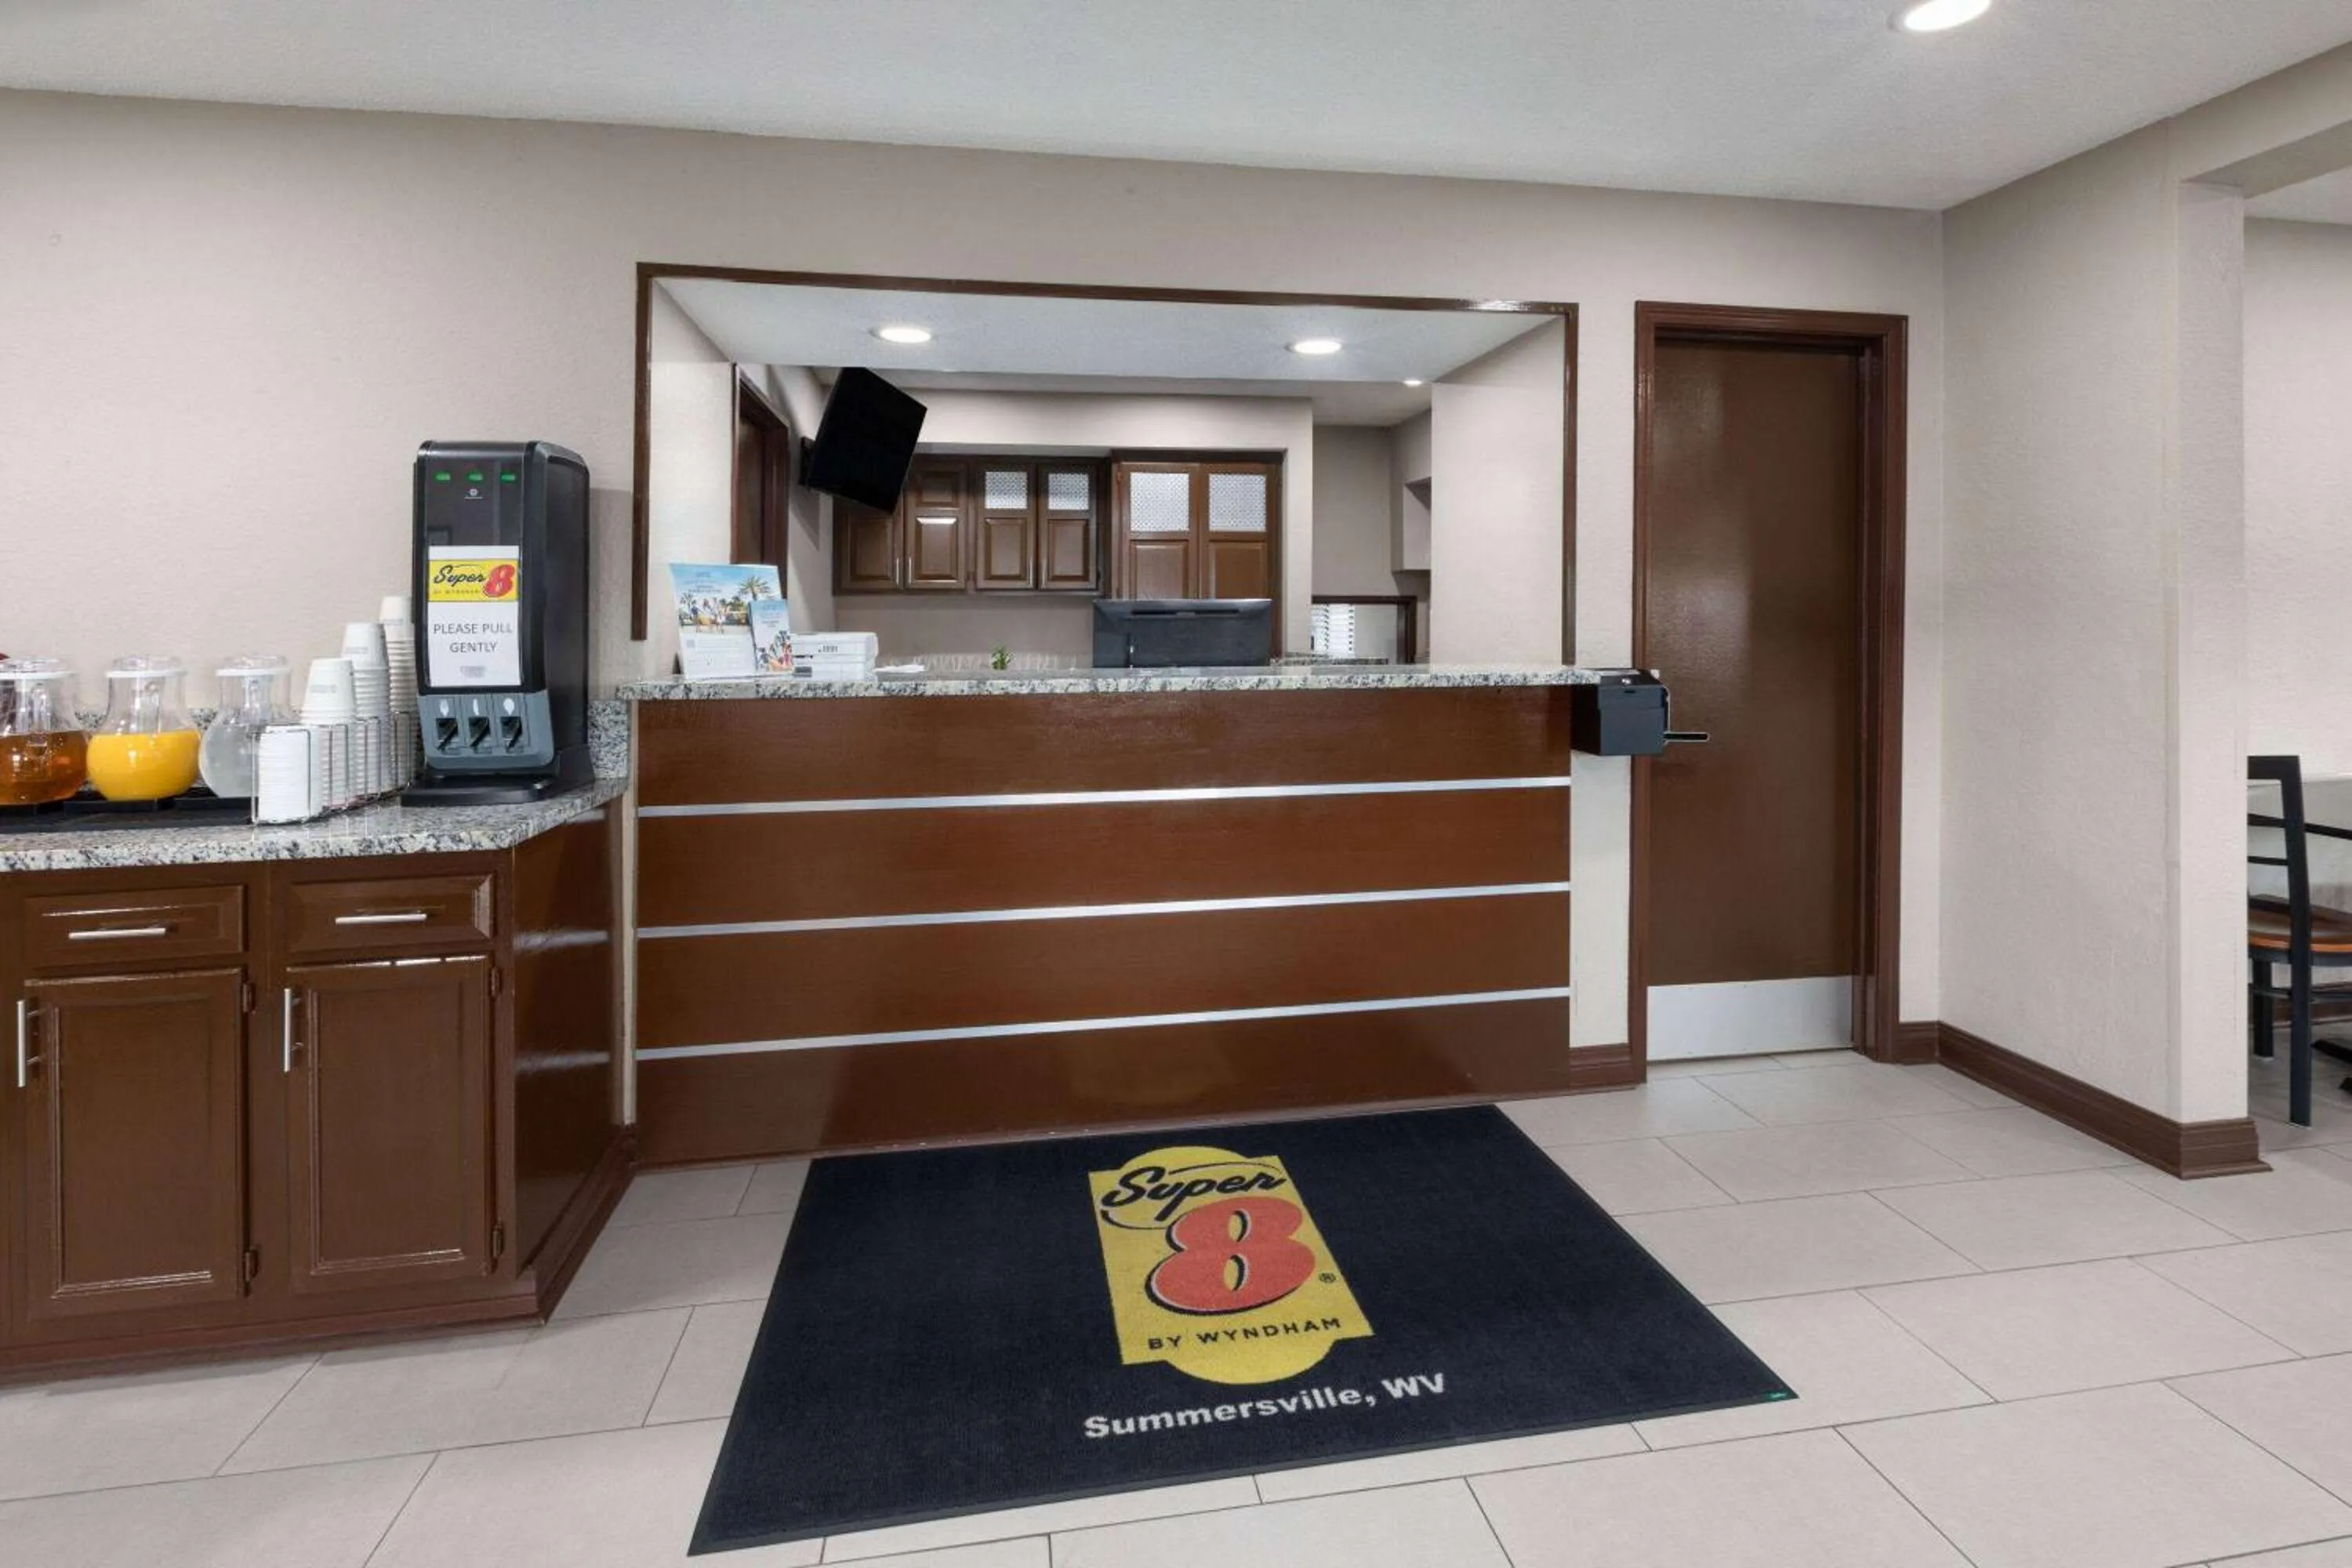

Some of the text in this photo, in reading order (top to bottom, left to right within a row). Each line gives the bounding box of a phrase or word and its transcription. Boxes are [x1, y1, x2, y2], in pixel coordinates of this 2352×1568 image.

[434, 564, 515, 597] Super 8
[433, 622, 513, 634] PLEASE PULL
[449, 642, 497, 653] GENTLY
[1101, 1166, 1287, 1222] Super
[1145, 1196, 1316, 1316] 8
[1148, 1317, 1341, 1351] BY WYNDHAM
[1083, 1372, 1445, 1439] Summersville, WV
